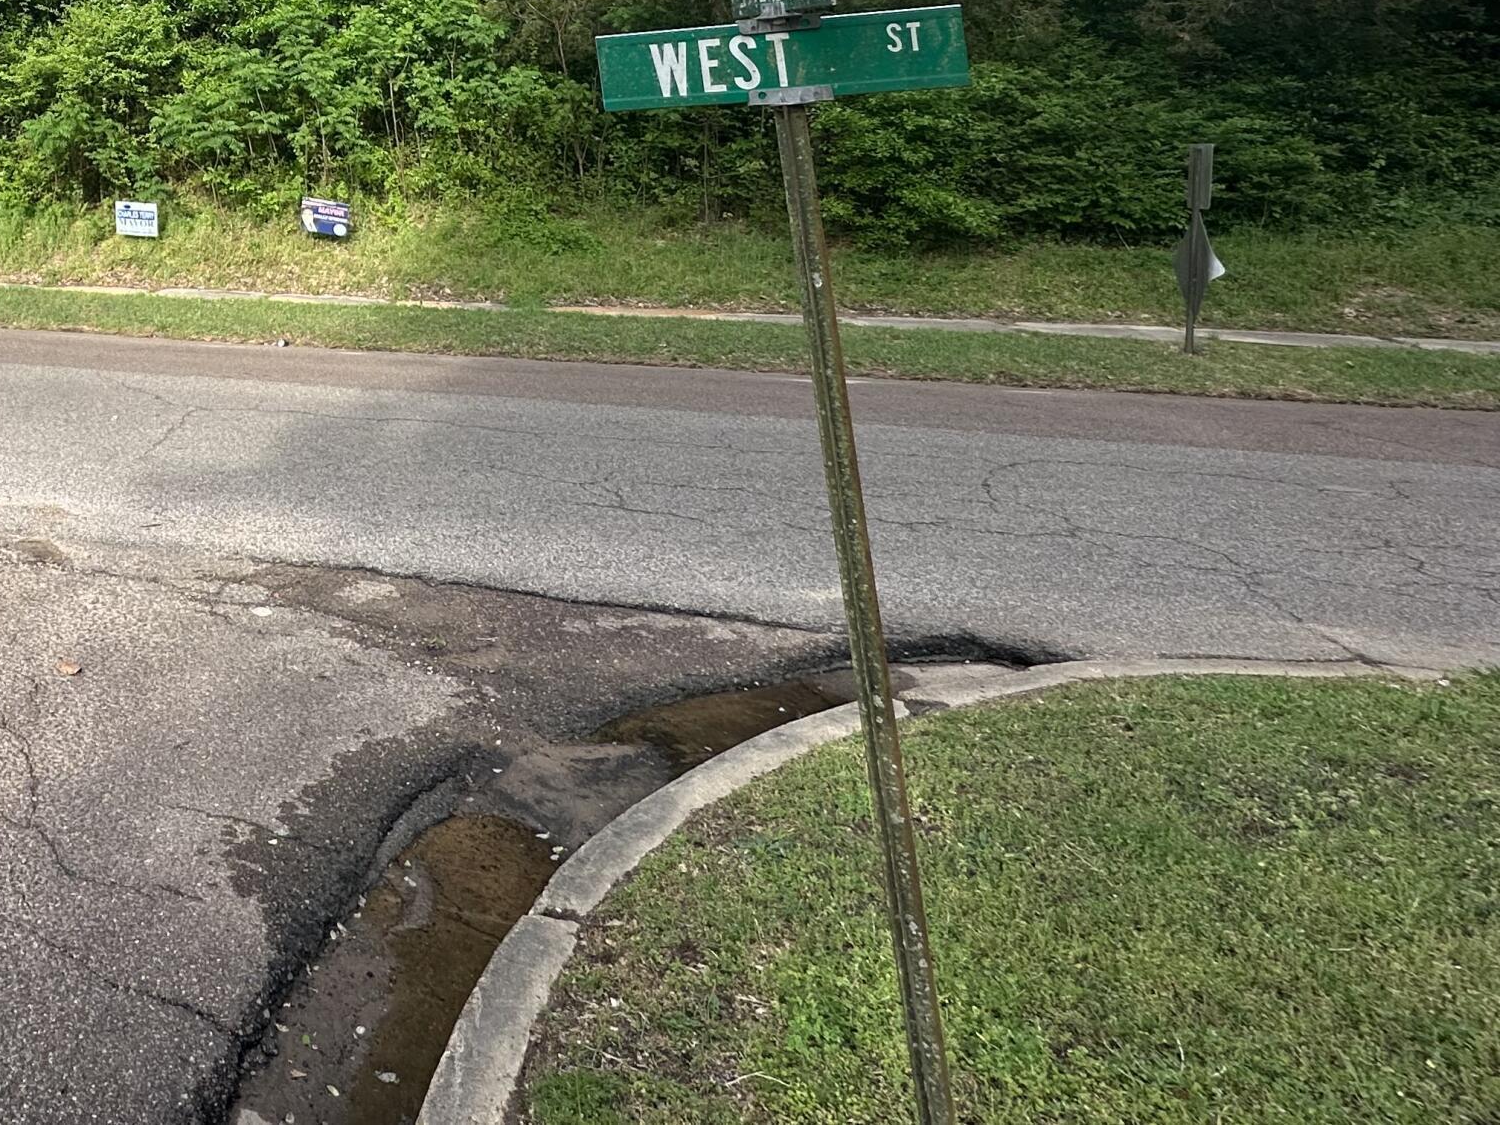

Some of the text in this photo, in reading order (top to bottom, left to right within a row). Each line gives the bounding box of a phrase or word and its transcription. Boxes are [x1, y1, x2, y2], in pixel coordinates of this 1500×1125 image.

[649, 21, 921, 97] WEST ST
[317, 206, 345, 217] MAYOR
[118, 218, 154, 228] MAYOR
